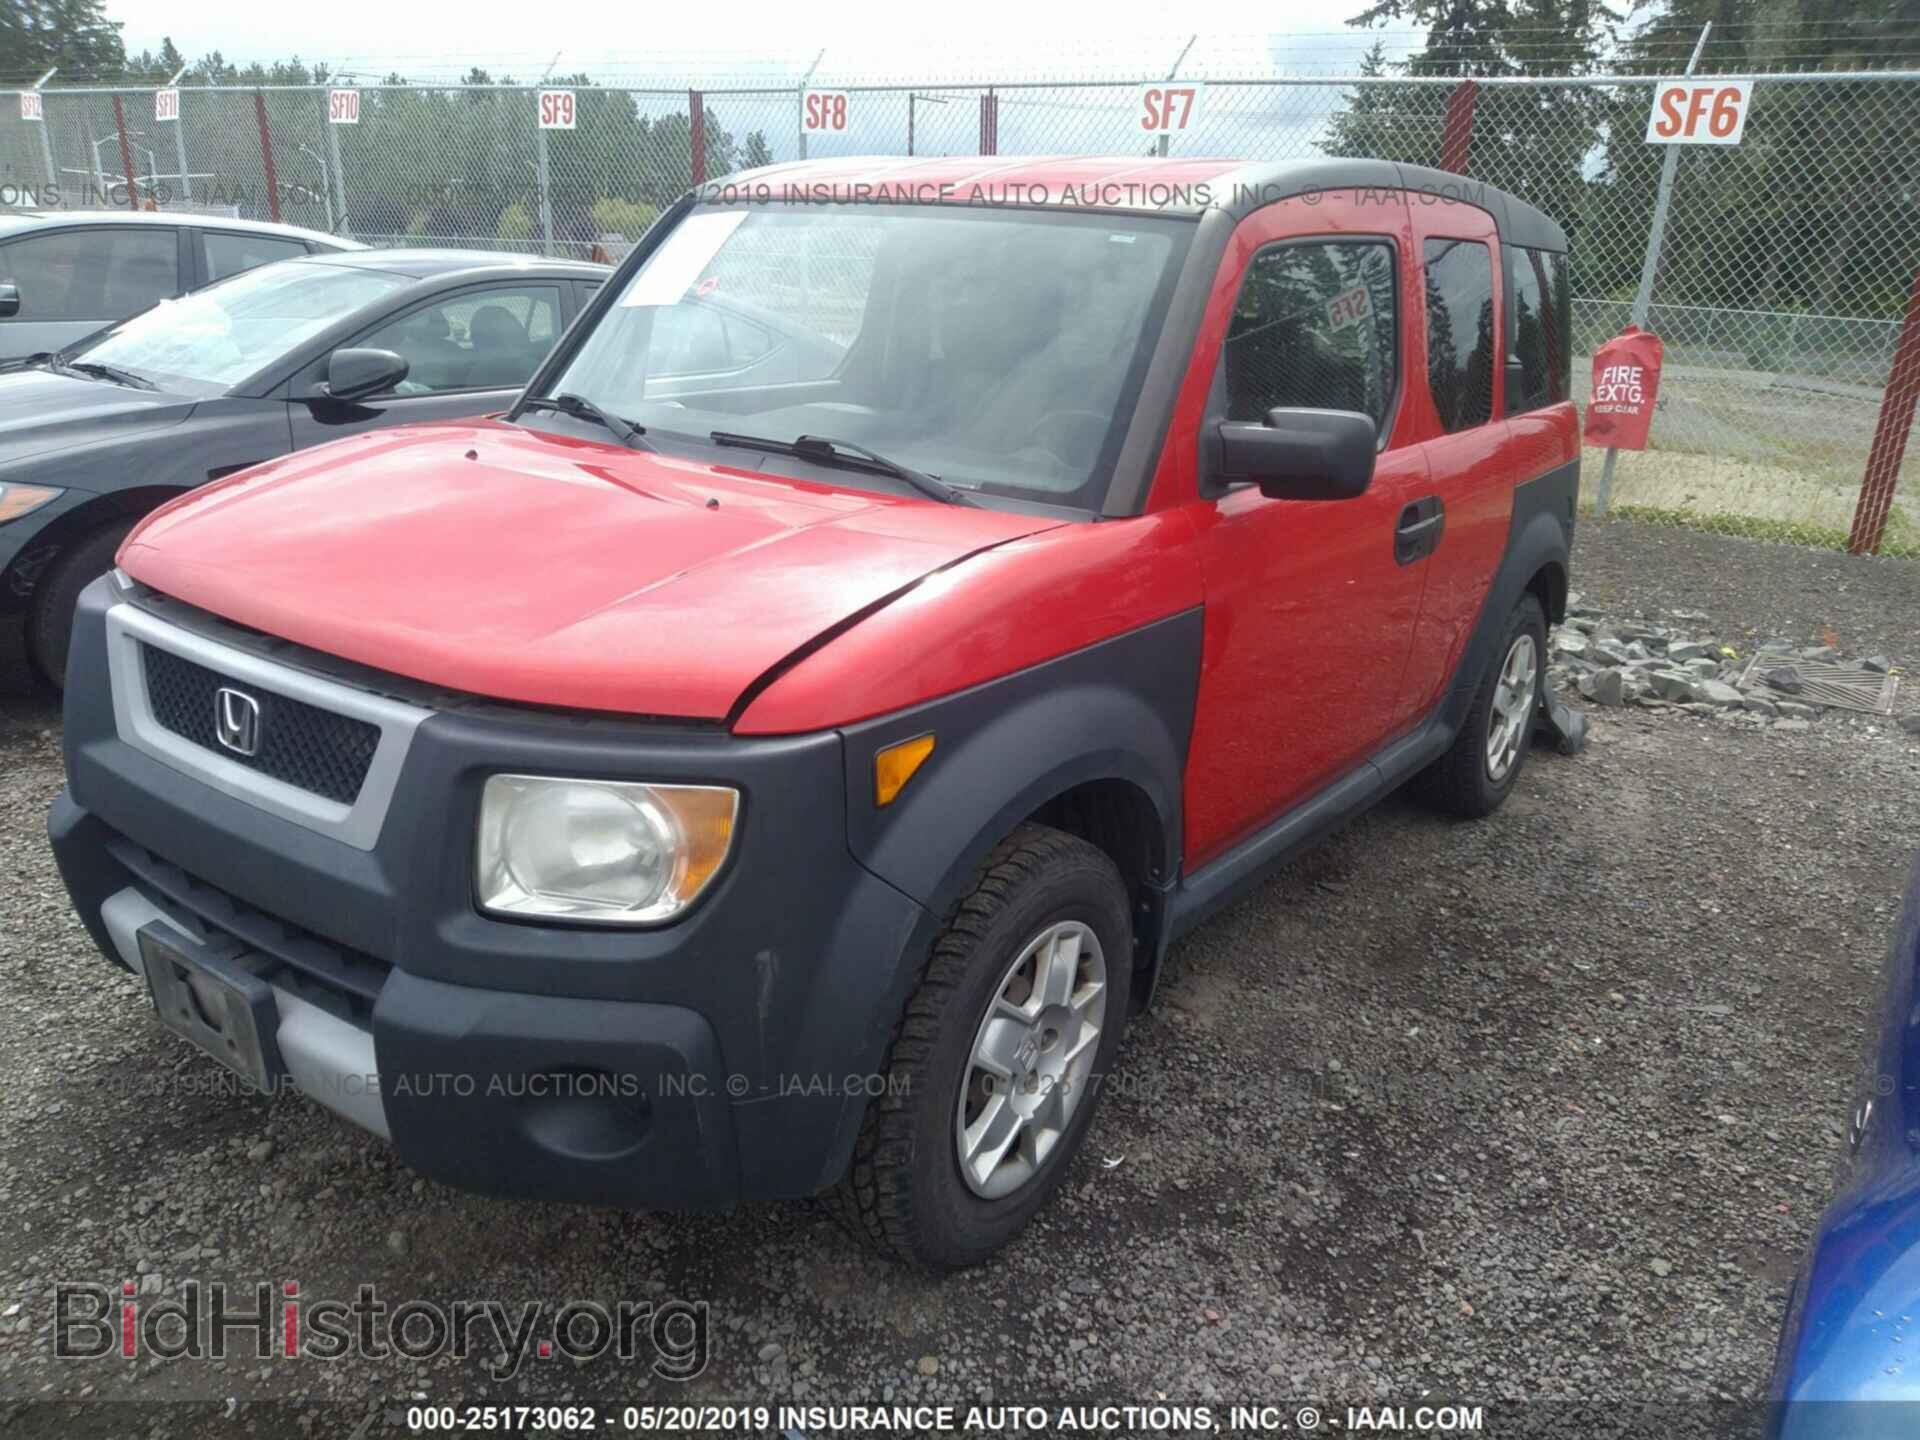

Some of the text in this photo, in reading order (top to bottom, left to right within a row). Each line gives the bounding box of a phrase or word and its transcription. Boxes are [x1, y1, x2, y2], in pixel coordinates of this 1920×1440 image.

[159, 92, 177, 117] SF11
[331, 92, 359, 119] SF10
[541, 94, 574, 125] SF9
[805, 93, 848, 131] SF8
[1140, 88, 1197, 131] SF7
[1655, 87, 1742, 138] SF6
[1601, 366, 1643, 385] FIRE
[1595, 384, 1645, 404] EXTG.
